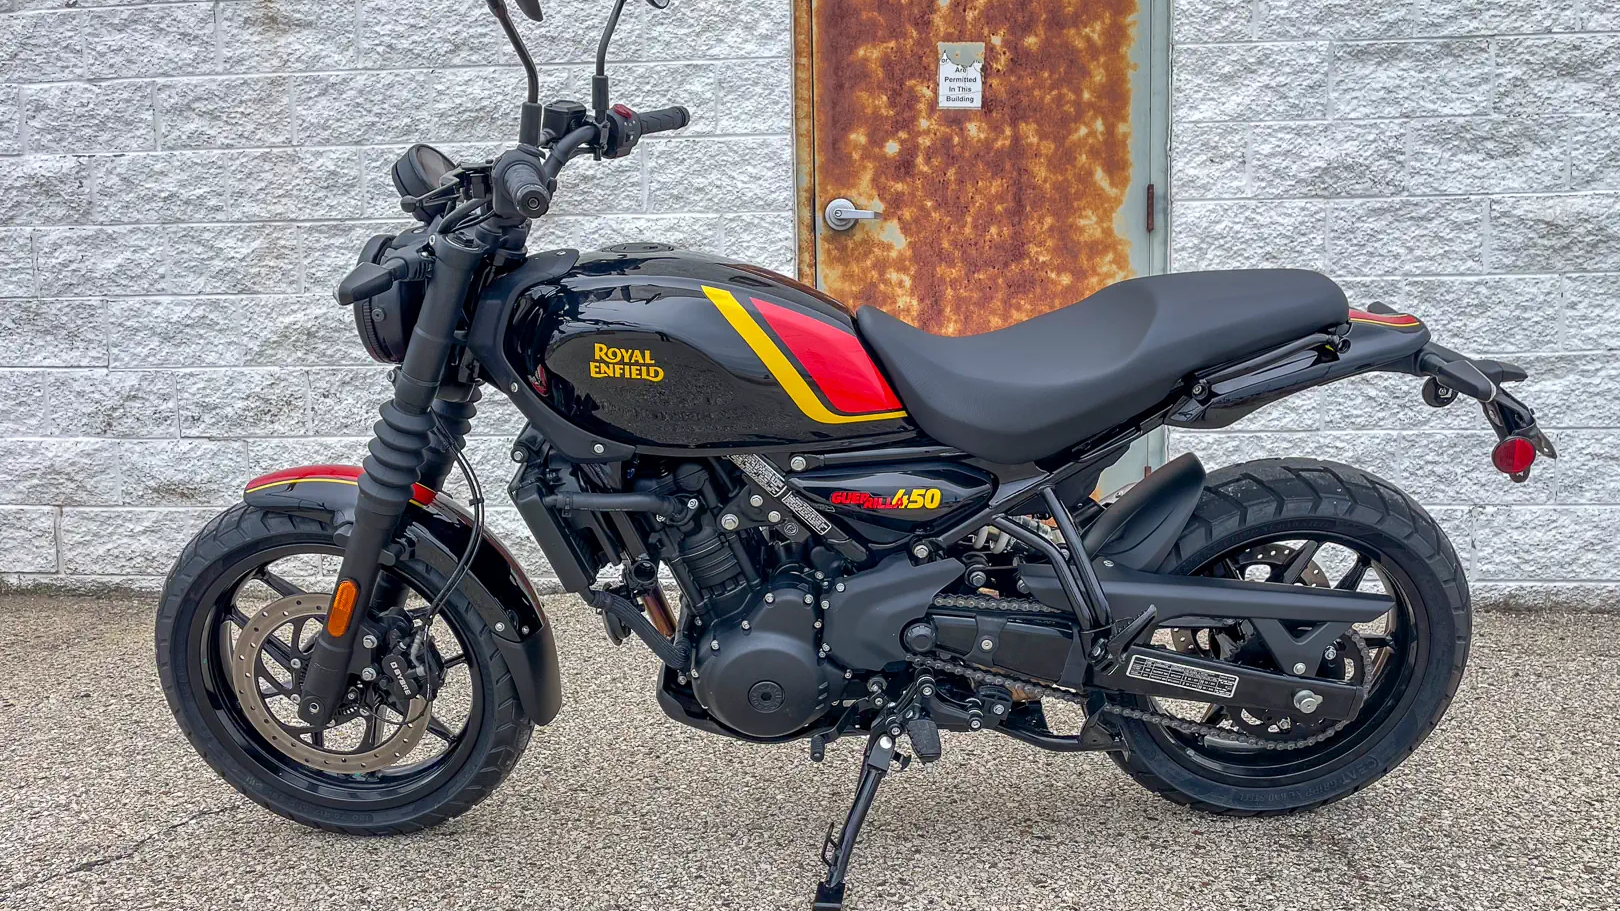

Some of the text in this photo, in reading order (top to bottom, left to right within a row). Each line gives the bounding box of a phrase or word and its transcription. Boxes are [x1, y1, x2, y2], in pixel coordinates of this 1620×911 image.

[593, 342, 656, 364] ROYAL
[589, 361, 665, 382] ENFIELD
[892, 488, 942, 509] 450
